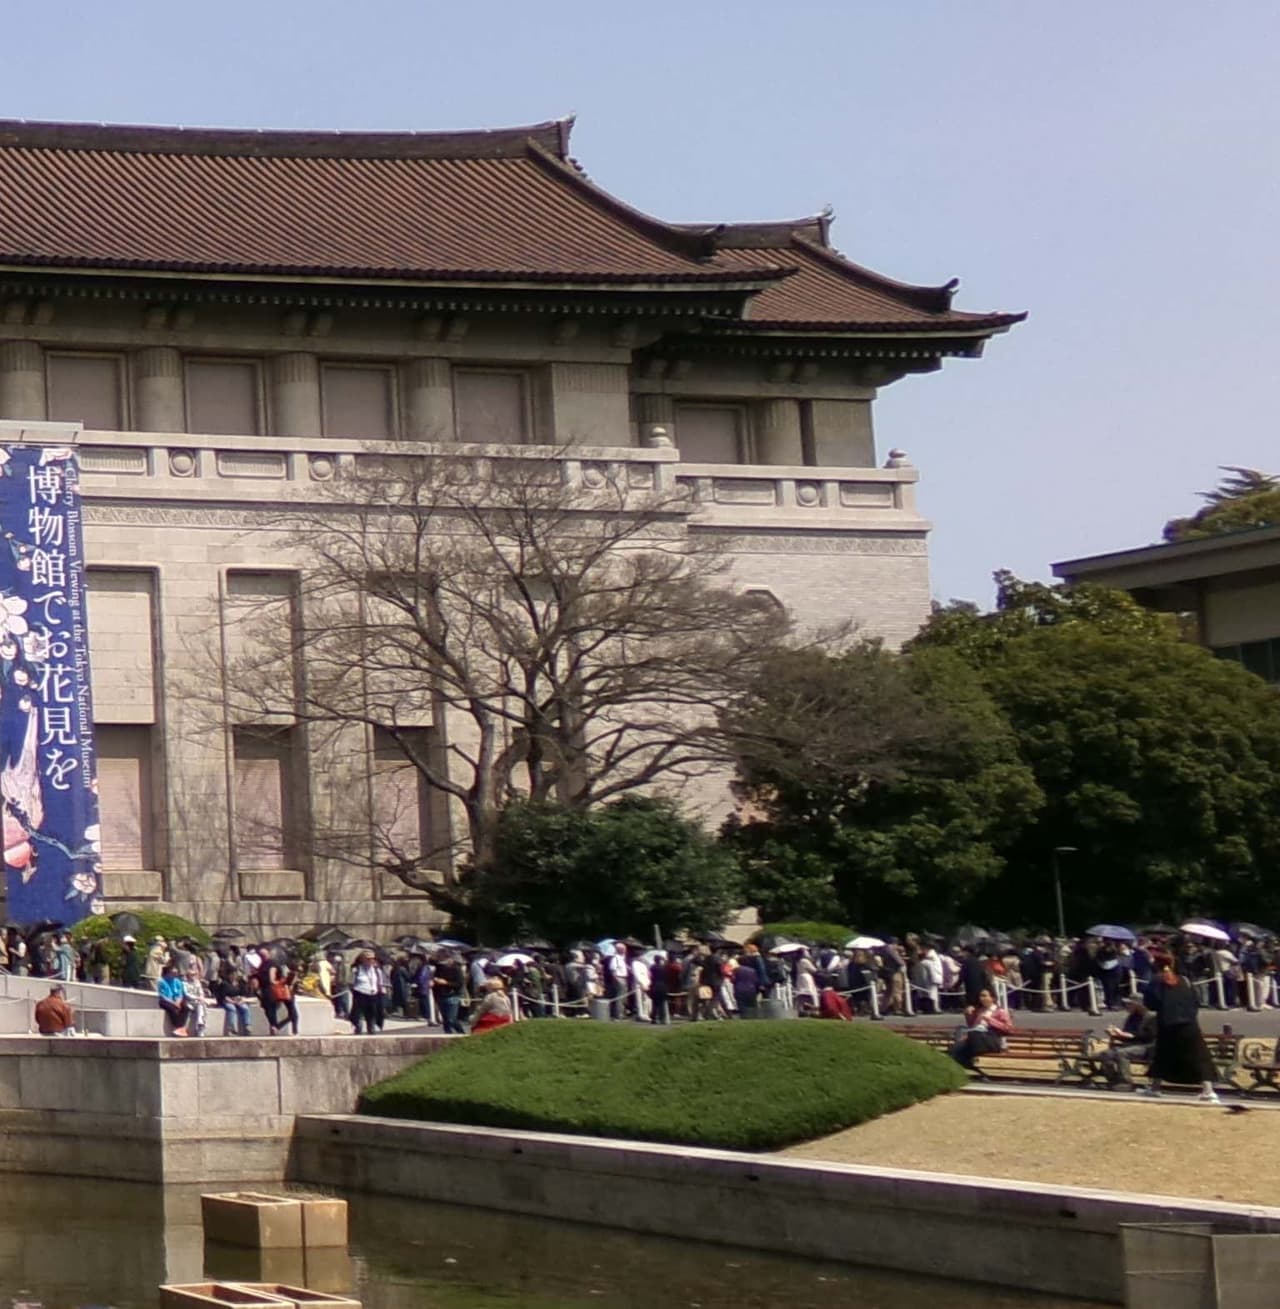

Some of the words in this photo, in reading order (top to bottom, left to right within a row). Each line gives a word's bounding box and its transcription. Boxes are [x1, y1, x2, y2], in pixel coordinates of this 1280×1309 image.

[63, 467, 77, 507] Cherry
[67, 510, 79, 556] Blossom
[68, 560, 83, 607] Viewing
[26, 465, 78, 790] 博物館でお花見を
[72, 609, 81, 620] at
[74, 623, 86, 642] the
[73, 646, 88, 682] Tokyo
[78, 685, 93, 735] National
[80, 737, 93, 788] Museum
